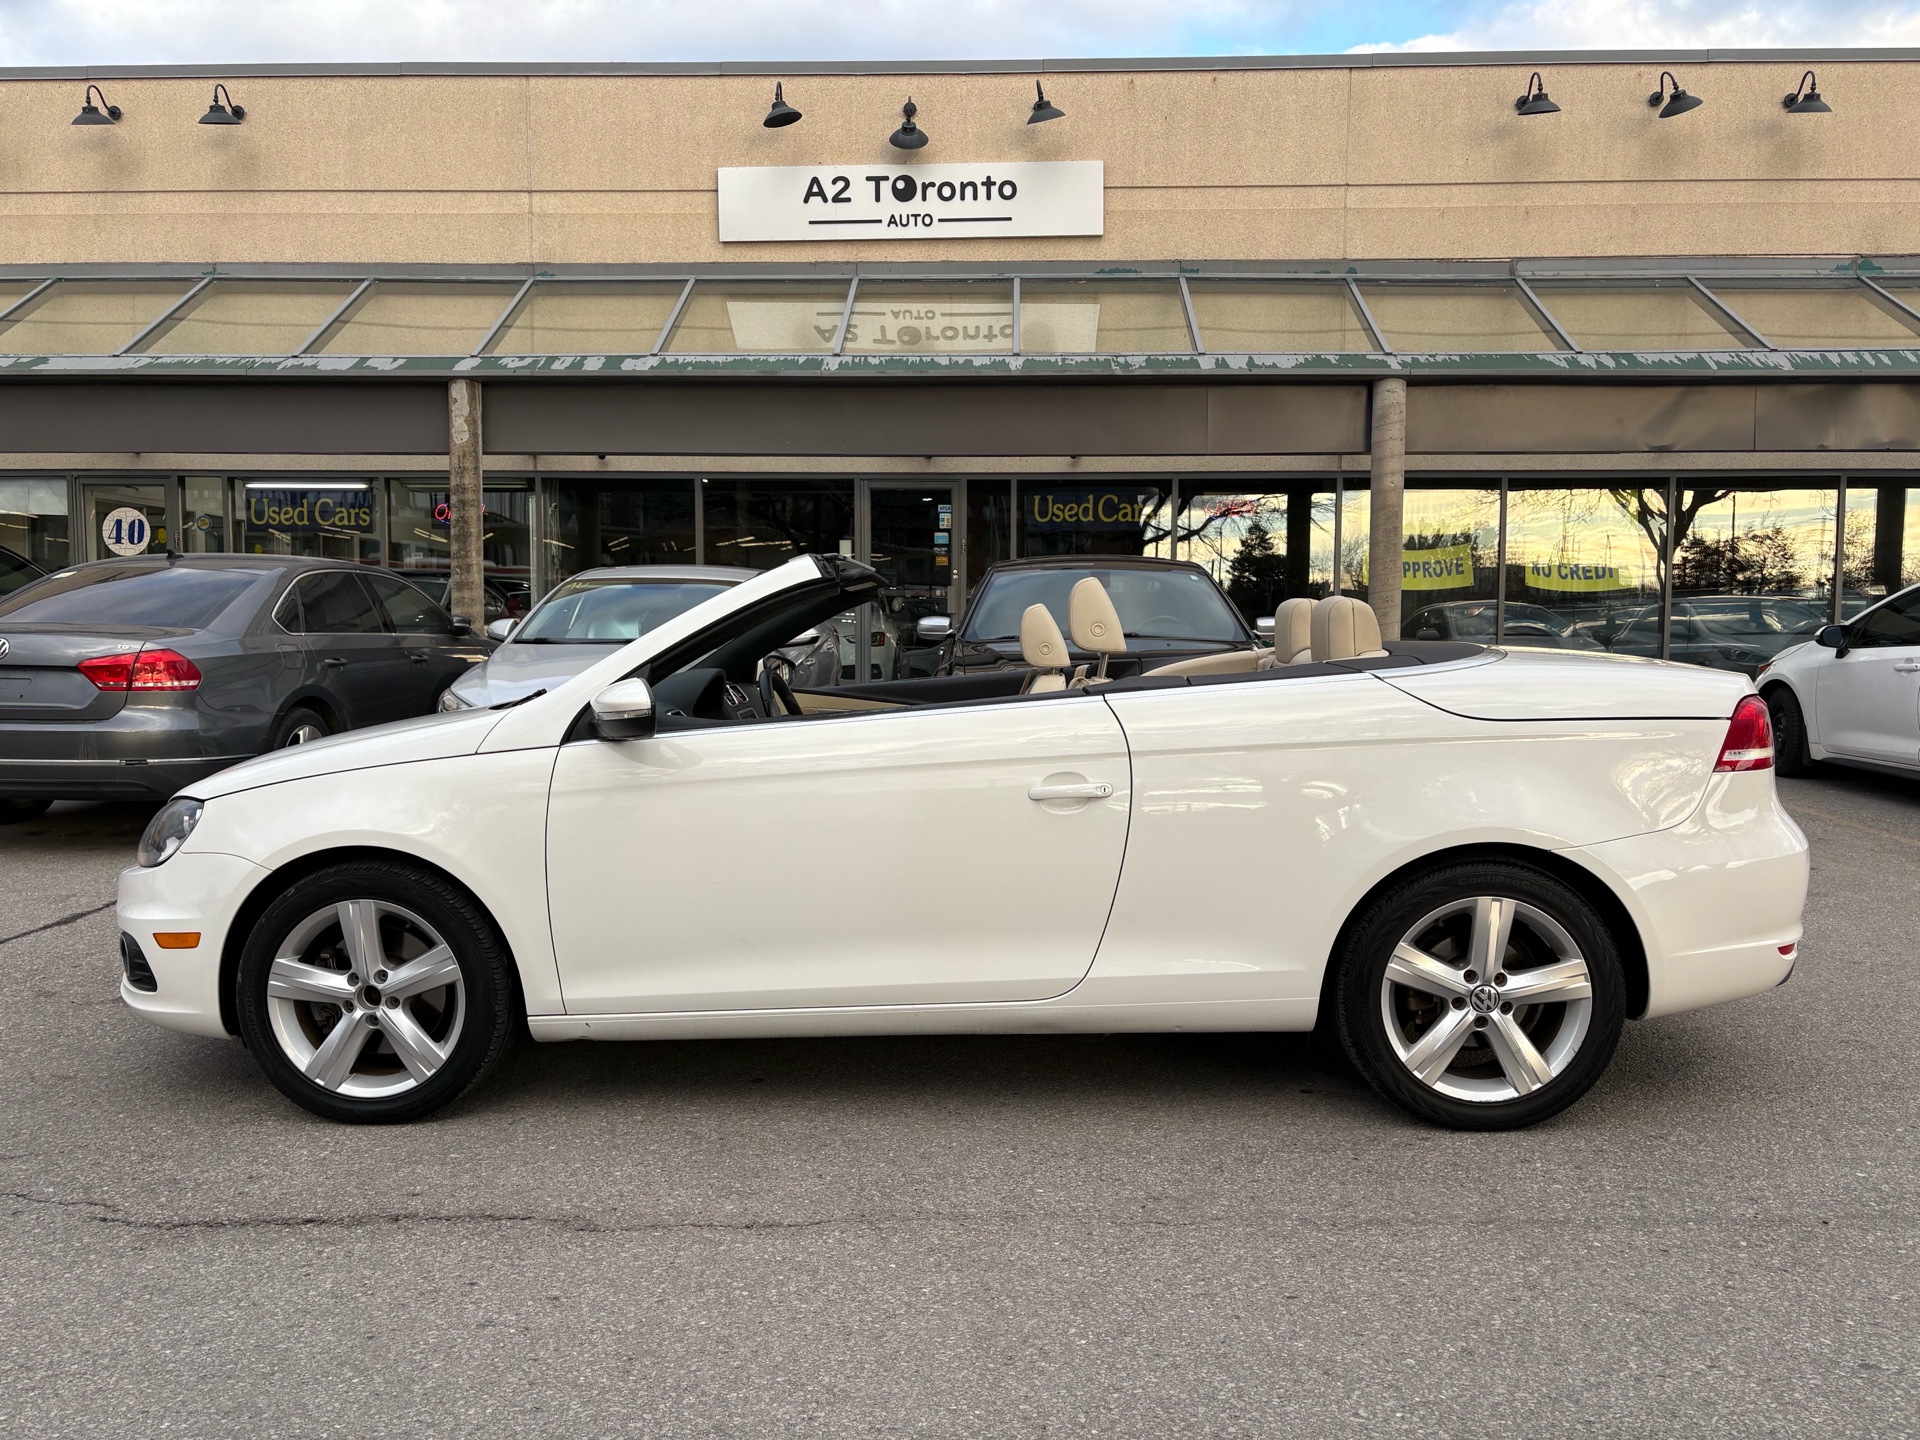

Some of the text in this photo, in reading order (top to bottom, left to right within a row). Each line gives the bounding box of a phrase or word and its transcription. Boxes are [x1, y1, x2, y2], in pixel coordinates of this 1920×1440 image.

[803, 176, 852, 204] A2
[887, 213, 933, 227] AUTO
[250, 498, 371, 526] Used Cars
[1033, 494, 1095, 522] Used
[108, 518, 145, 545] 40
[1402, 556, 1465, 579] PPROVE
[1557, 563, 1614, 581] CREDI
